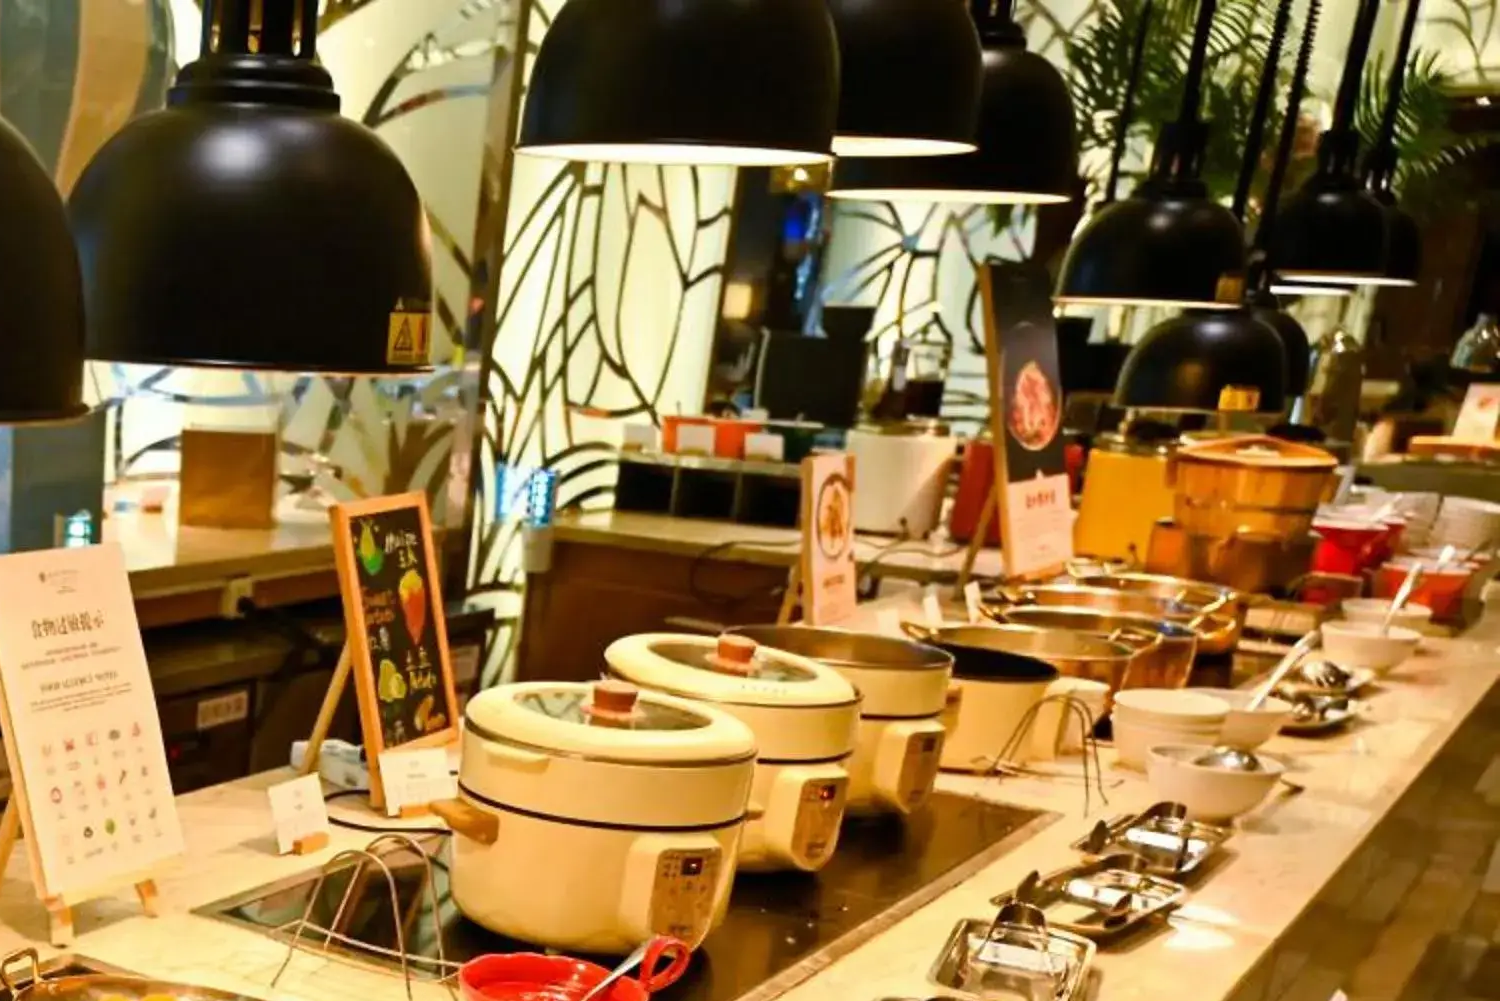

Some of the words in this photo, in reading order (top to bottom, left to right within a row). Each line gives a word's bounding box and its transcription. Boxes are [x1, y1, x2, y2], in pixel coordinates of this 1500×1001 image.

[31, 609, 105, 640] 食物过敏提示
